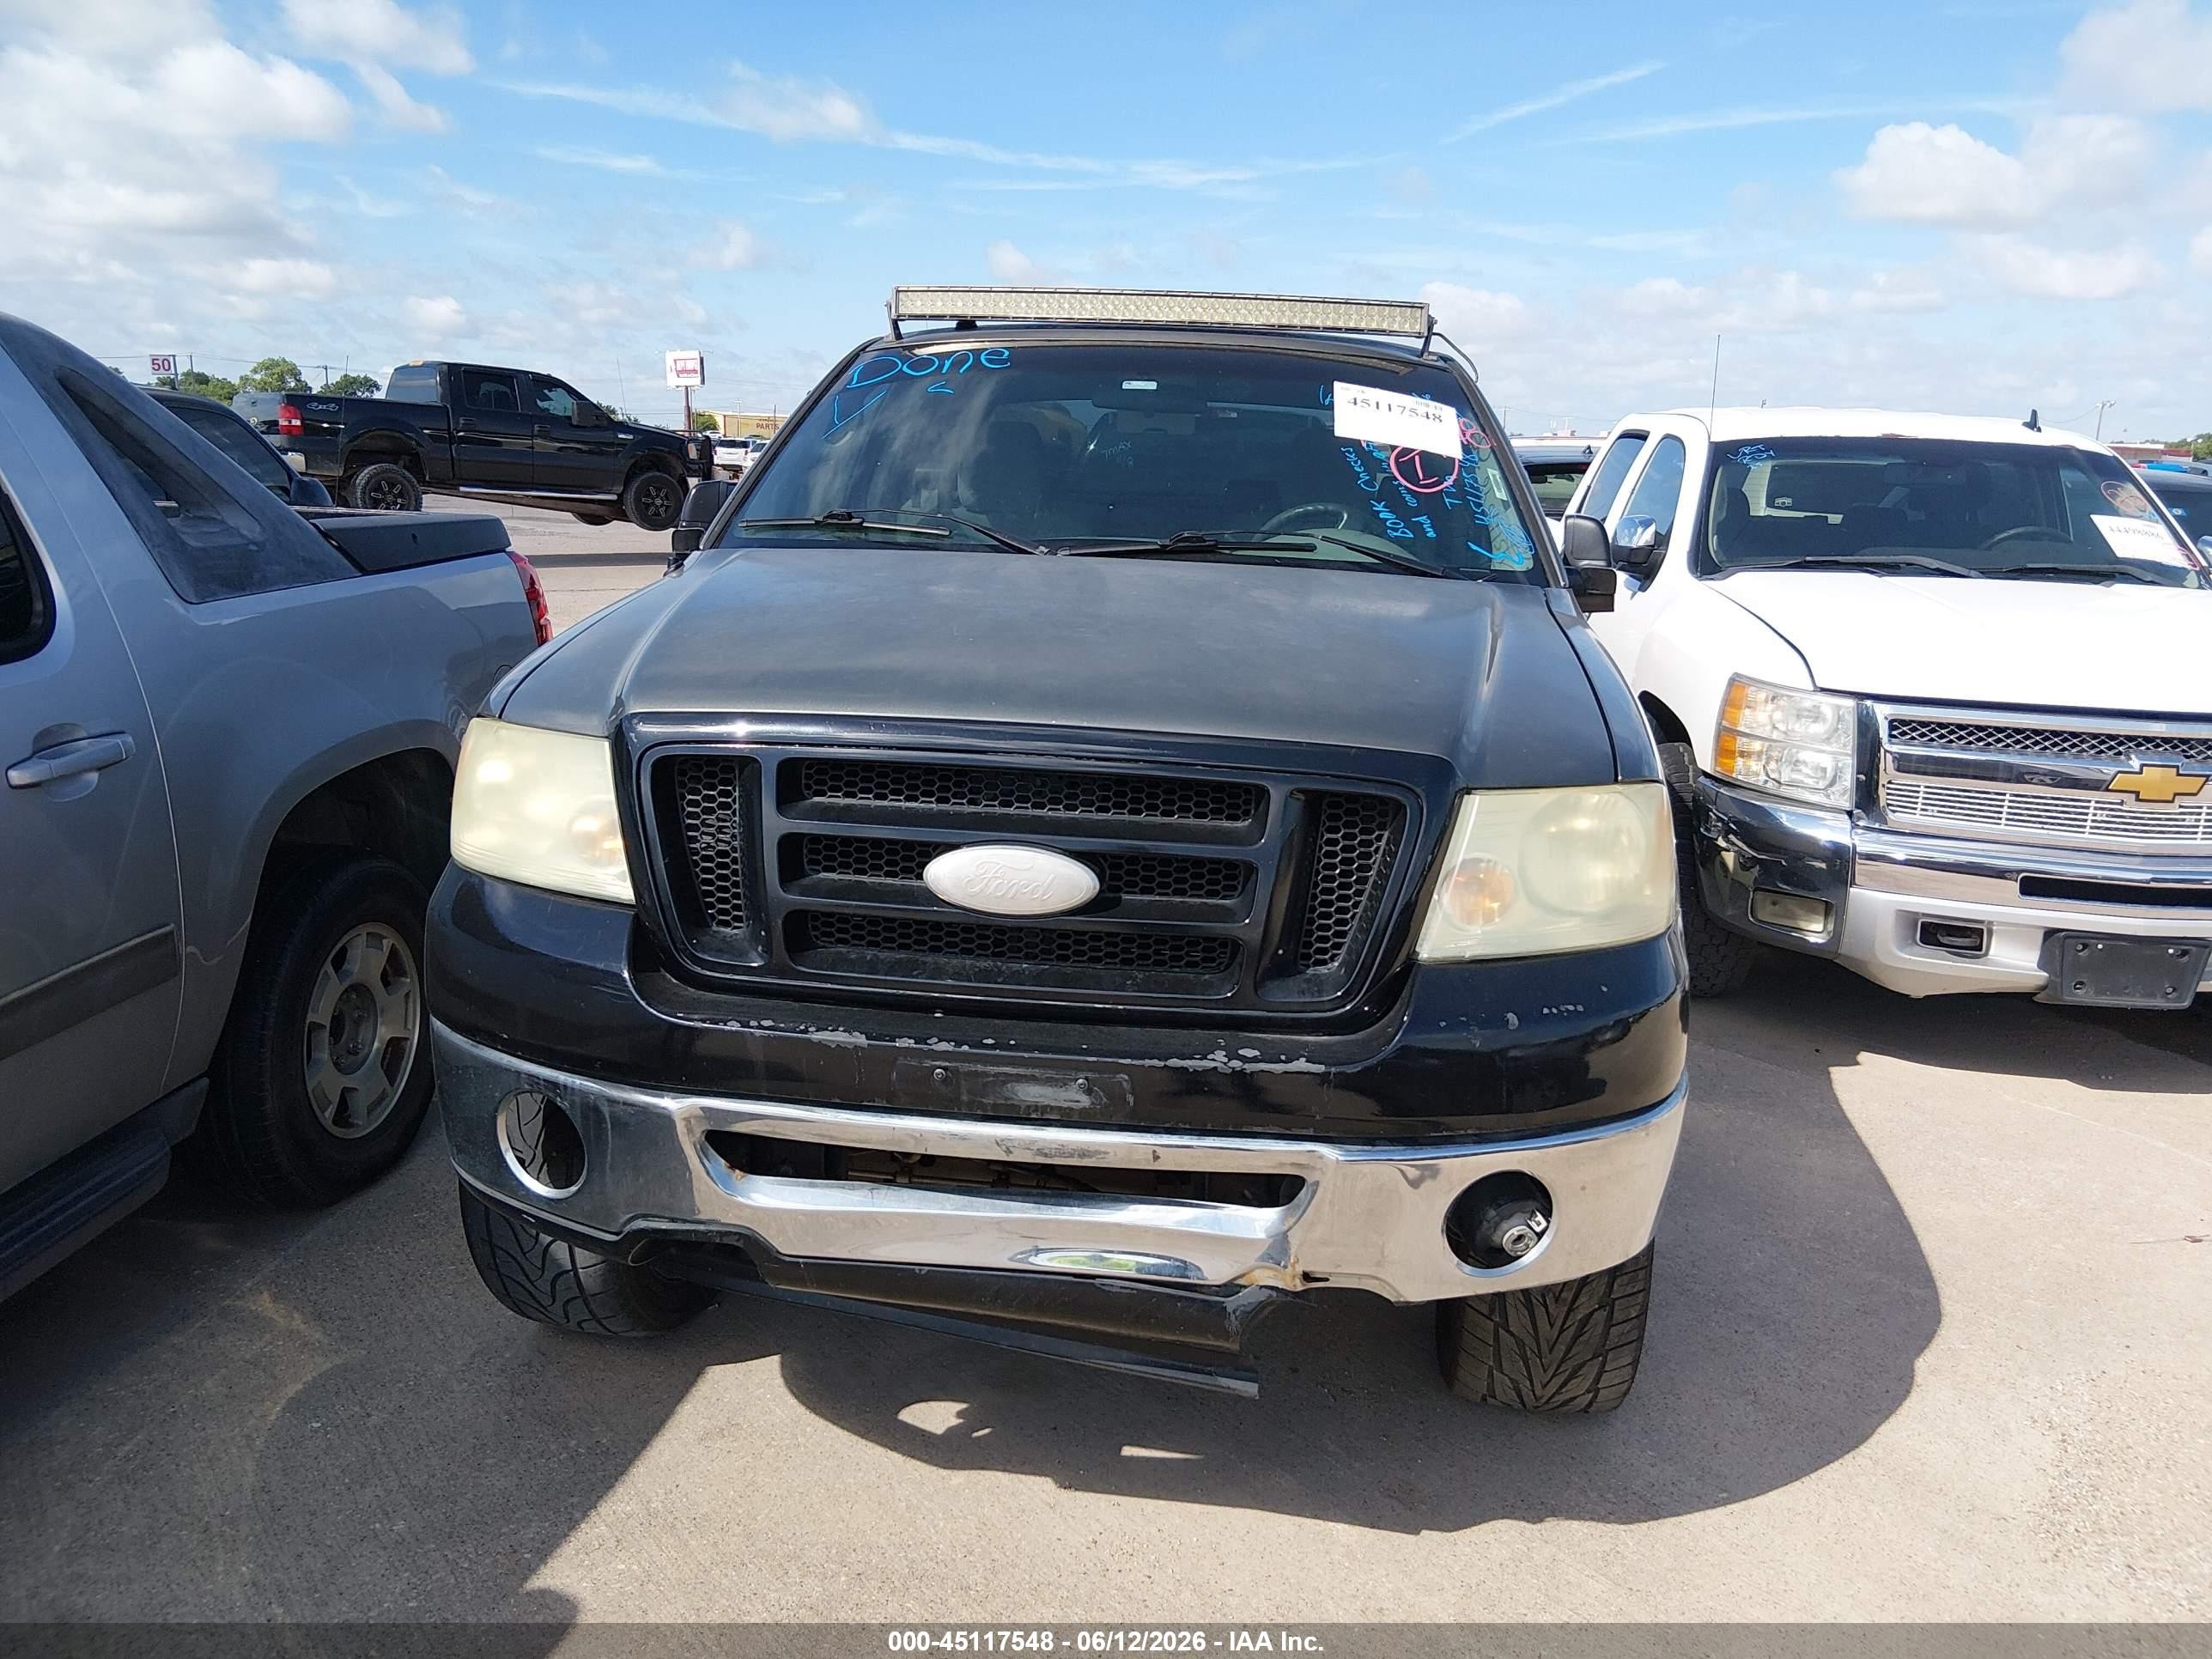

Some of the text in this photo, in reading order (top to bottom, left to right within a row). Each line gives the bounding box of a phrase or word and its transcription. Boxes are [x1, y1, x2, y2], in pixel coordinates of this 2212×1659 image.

[151, 358, 172, 372] 50
[845, 347, 1011, 389] Done
[1346, 396, 1444, 424] 45117548
[962, 859, 1056, 902] Ford
